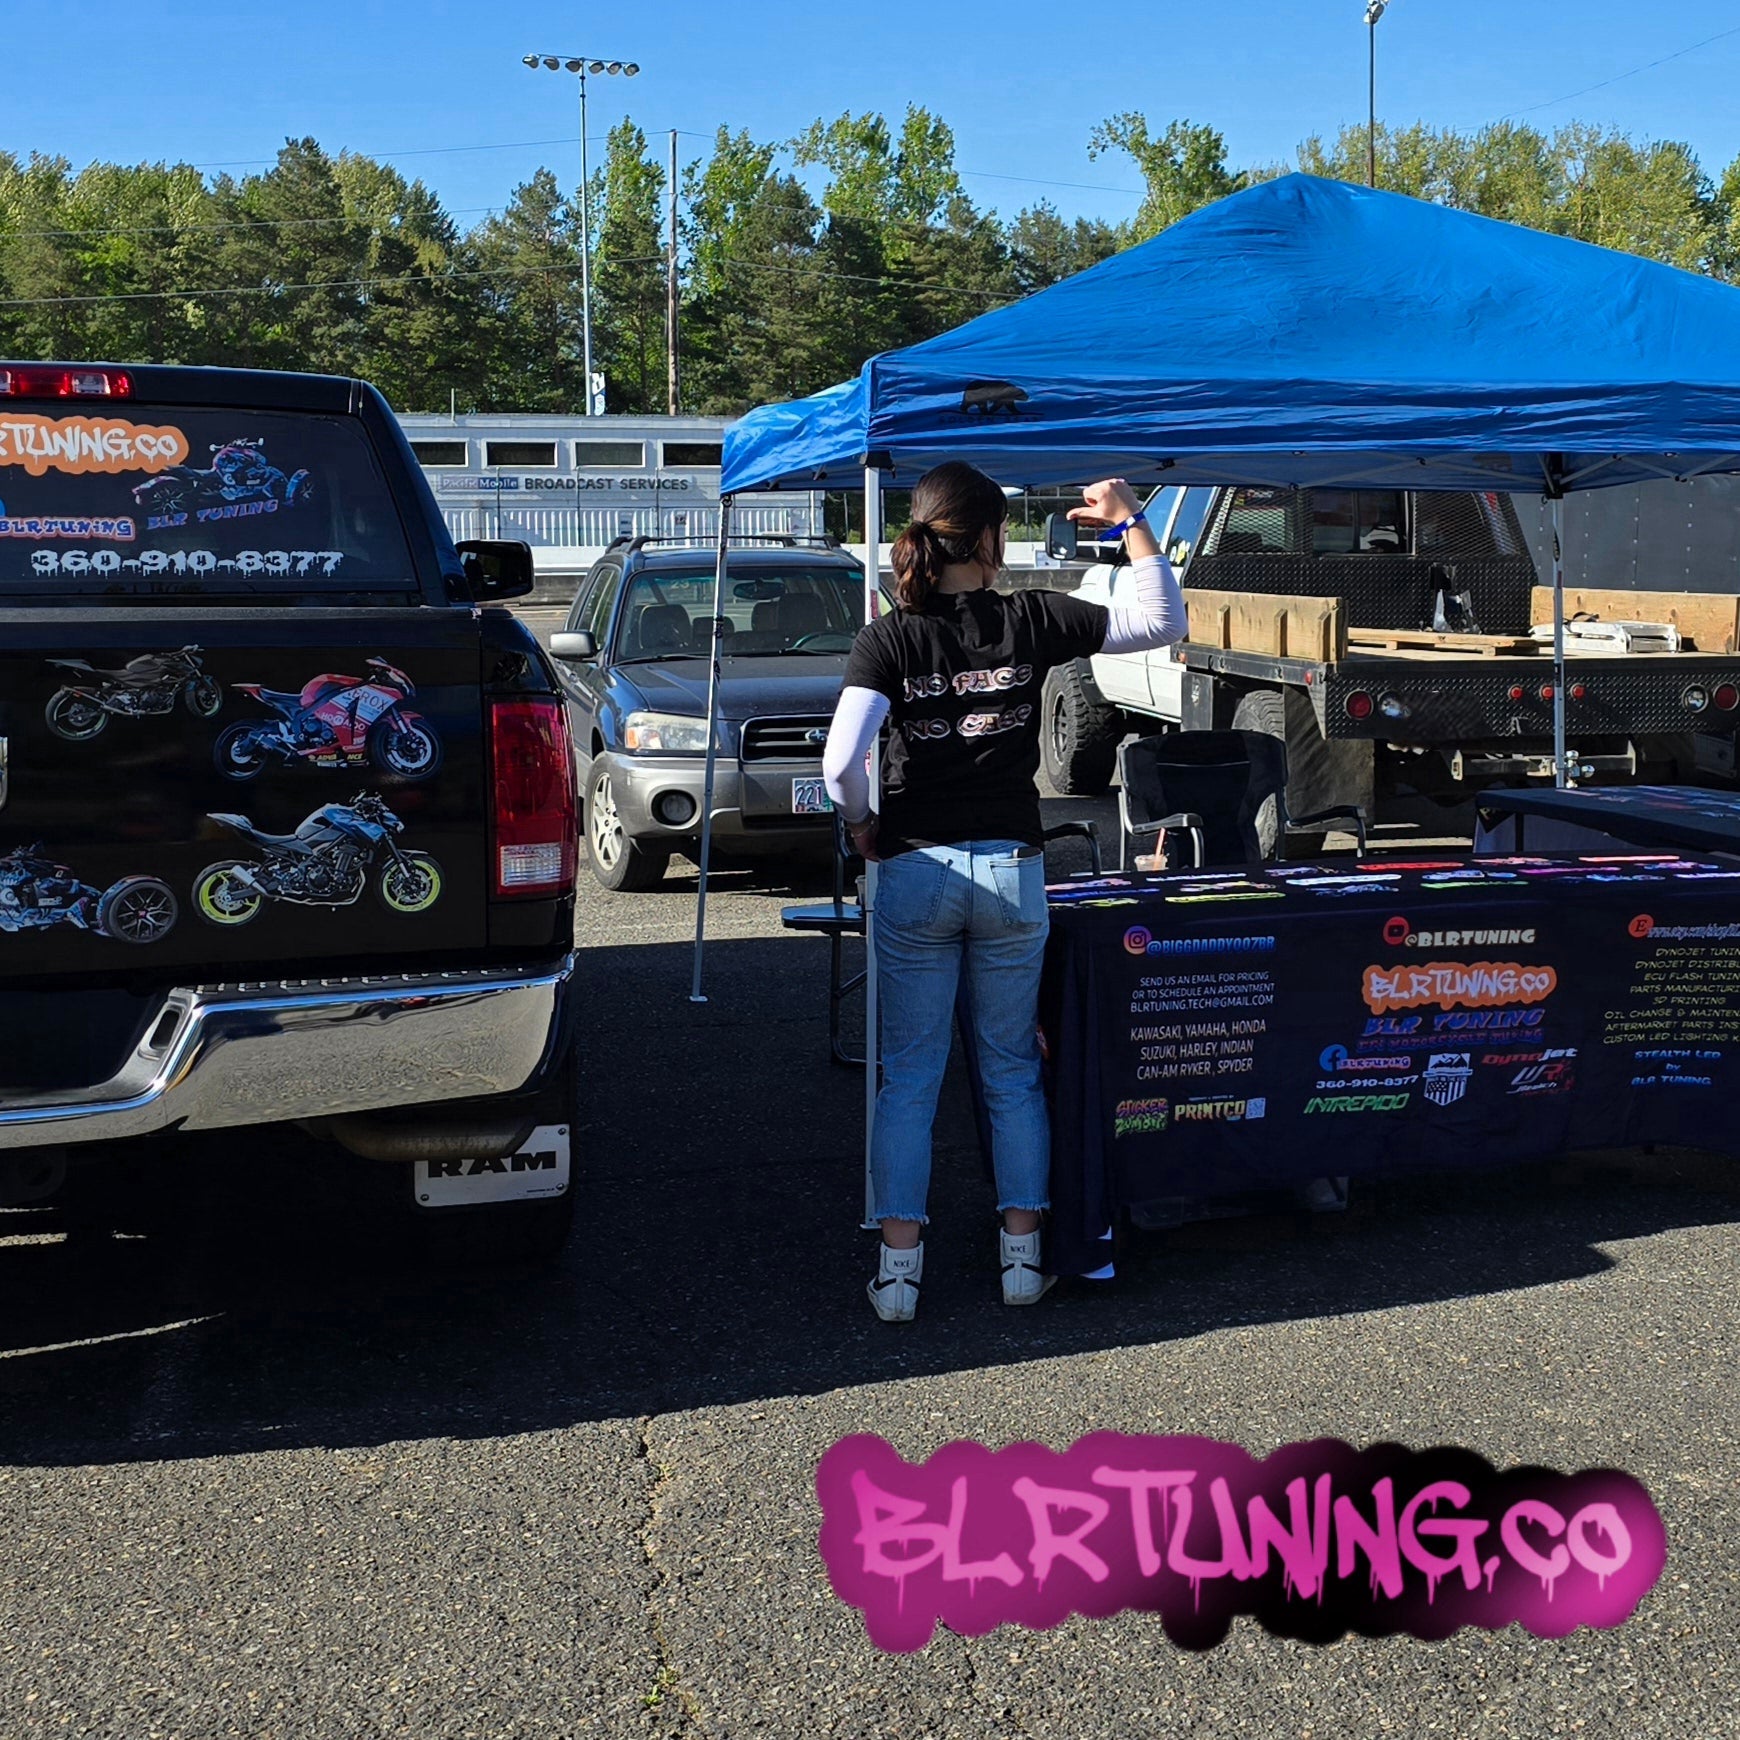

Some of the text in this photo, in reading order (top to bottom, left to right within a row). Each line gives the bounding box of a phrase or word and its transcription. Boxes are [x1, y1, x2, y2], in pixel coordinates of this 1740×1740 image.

[0, 422, 178, 463] TUNING.CO
[524, 477, 613, 490] BROADCAST
[620, 478, 688, 491] SERVICES
[147, 499, 278, 530] BLR TUNING
[31, 550, 344, 578] 360-910-8377
[903, 674, 948, 702] NO
[904, 719, 951, 742] NO
[1404, 928, 1536, 947] @BLRTUNING
[1655, 947, 1706, 957] DYNOJET
[1635, 960, 1684, 969] DYNOJET
[1140, 971, 1269, 987] SEND US AN EMAIL FOR PRICING
[1369, 968, 1550, 1001] BLRTUNING.CO
[1644, 972, 1666, 981] ECU
[1669, 972, 1703, 981] FLASH
[1132, 983, 1275, 1000] OR TO SCHEDULE AN APPOINTMENT
[1630, 985, 1661, 994] PARTS
[1131, 995, 1274, 1012] BLRTUNING.TECH@GMAIL.COM
[1671, 996, 1726, 1005] PRINTING
[1361, 1008, 1545, 1036] BLR TUNING
[1604, 1010, 1625, 1019] OIL
[1629, 1008, 1672, 1018] CHANGE
[1130, 1019, 1266, 1041] KAWASAKI, YAMAHA, HONDA
[1605, 1021, 1677, 1031] AFTERMARKET
[1681, 1021, 1714, 1030] PARTS
[1603, 1033, 1645, 1044] CUSTOM
[1649, 1032, 1671, 1041] LED
[1673, 1032, 1728, 1041] LIGHTING
[1140, 1039, 1255, 1060] SUZUKI, HARLEY, INDIAN
[1635, 1050, 1721, 1059] STEALTH LED
[1137, 1065, 1178, 1080] CAN-AM
[1217, 1058, 1253, 1074] SPYDER
[1315, 1074, 1419, 1089] 360-910-8377
[1631, 1075, 1712, 1085] BLR TUNING
[1174, 1100, 1245, 1121] PRINTCO
[1303, 1093, 1410, 1114] INTREPIDO
[428, 1151, 557, 1178] RAM
